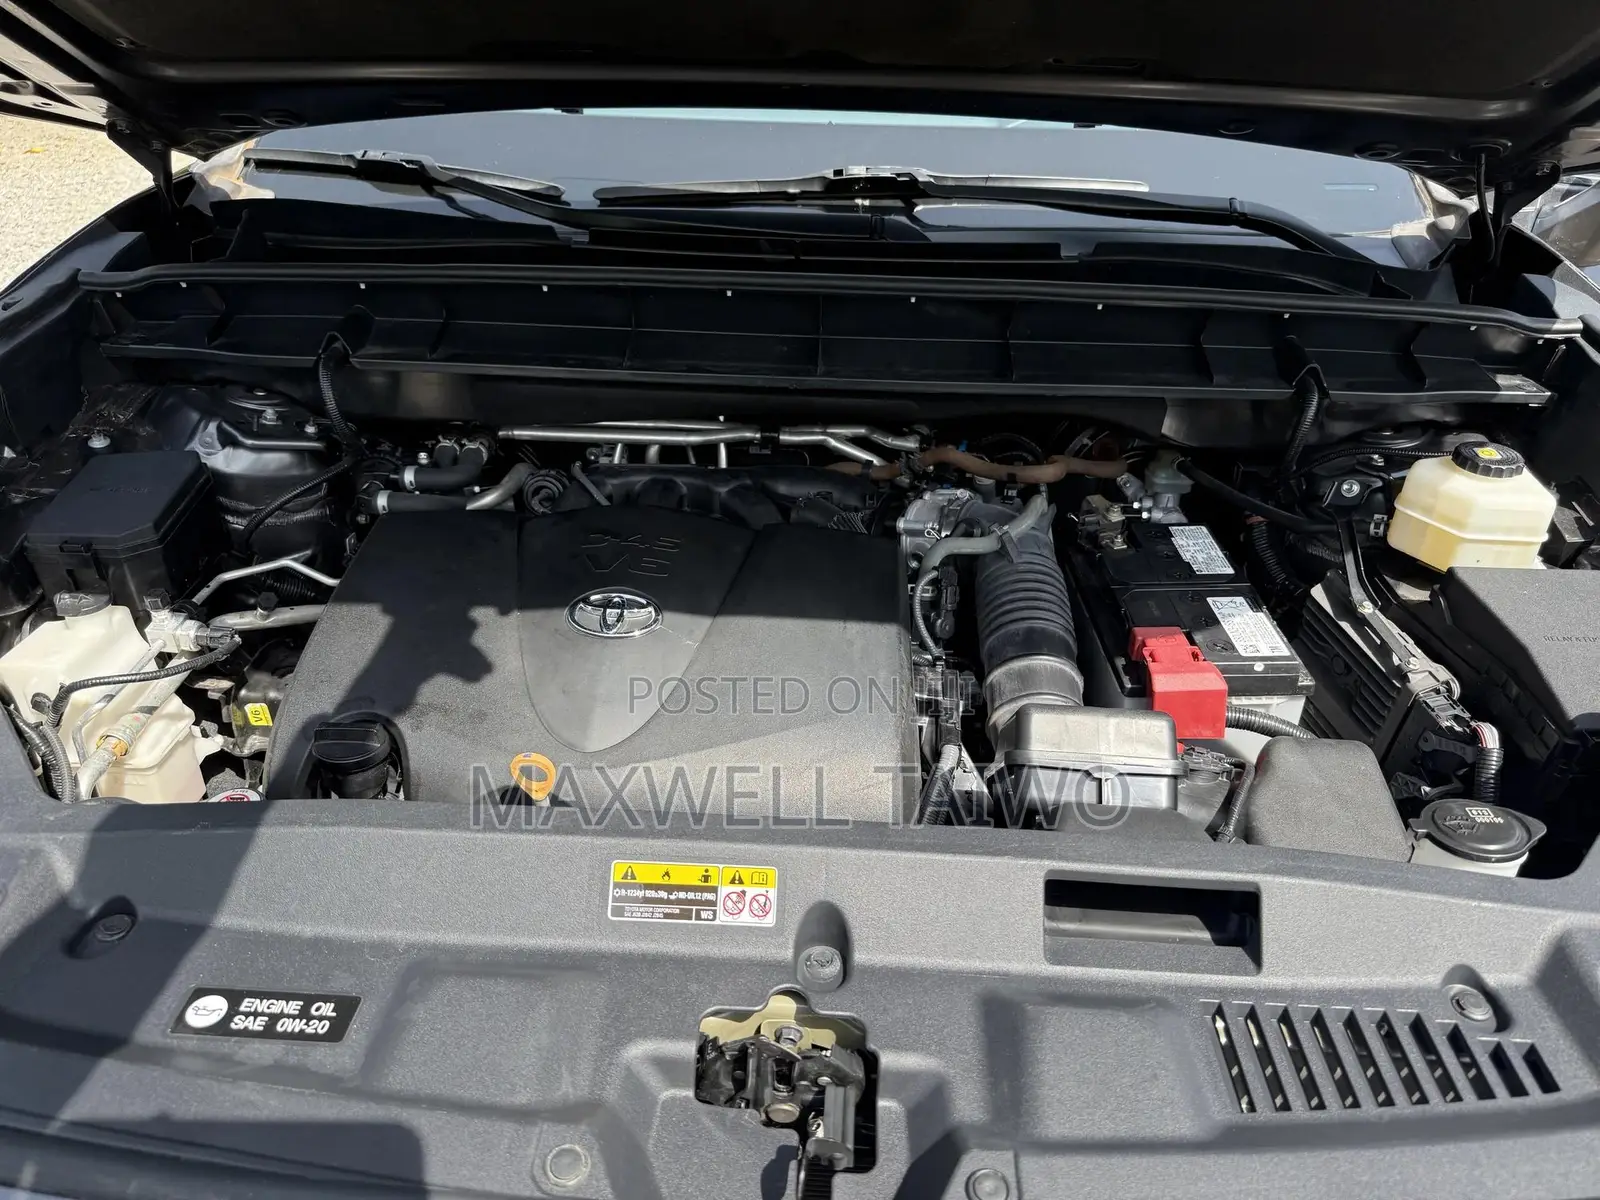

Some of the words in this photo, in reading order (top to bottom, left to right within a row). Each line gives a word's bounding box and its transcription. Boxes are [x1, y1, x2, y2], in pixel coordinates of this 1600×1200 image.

[700, 910, 714, 919] WS
[239, 998, 303, 1014] ENGINE
[310, 1001, 337, 1017] OIL
[230, 1015, 268, 1031] SAE
[276, 1019, 330, 1035] 0W-20
